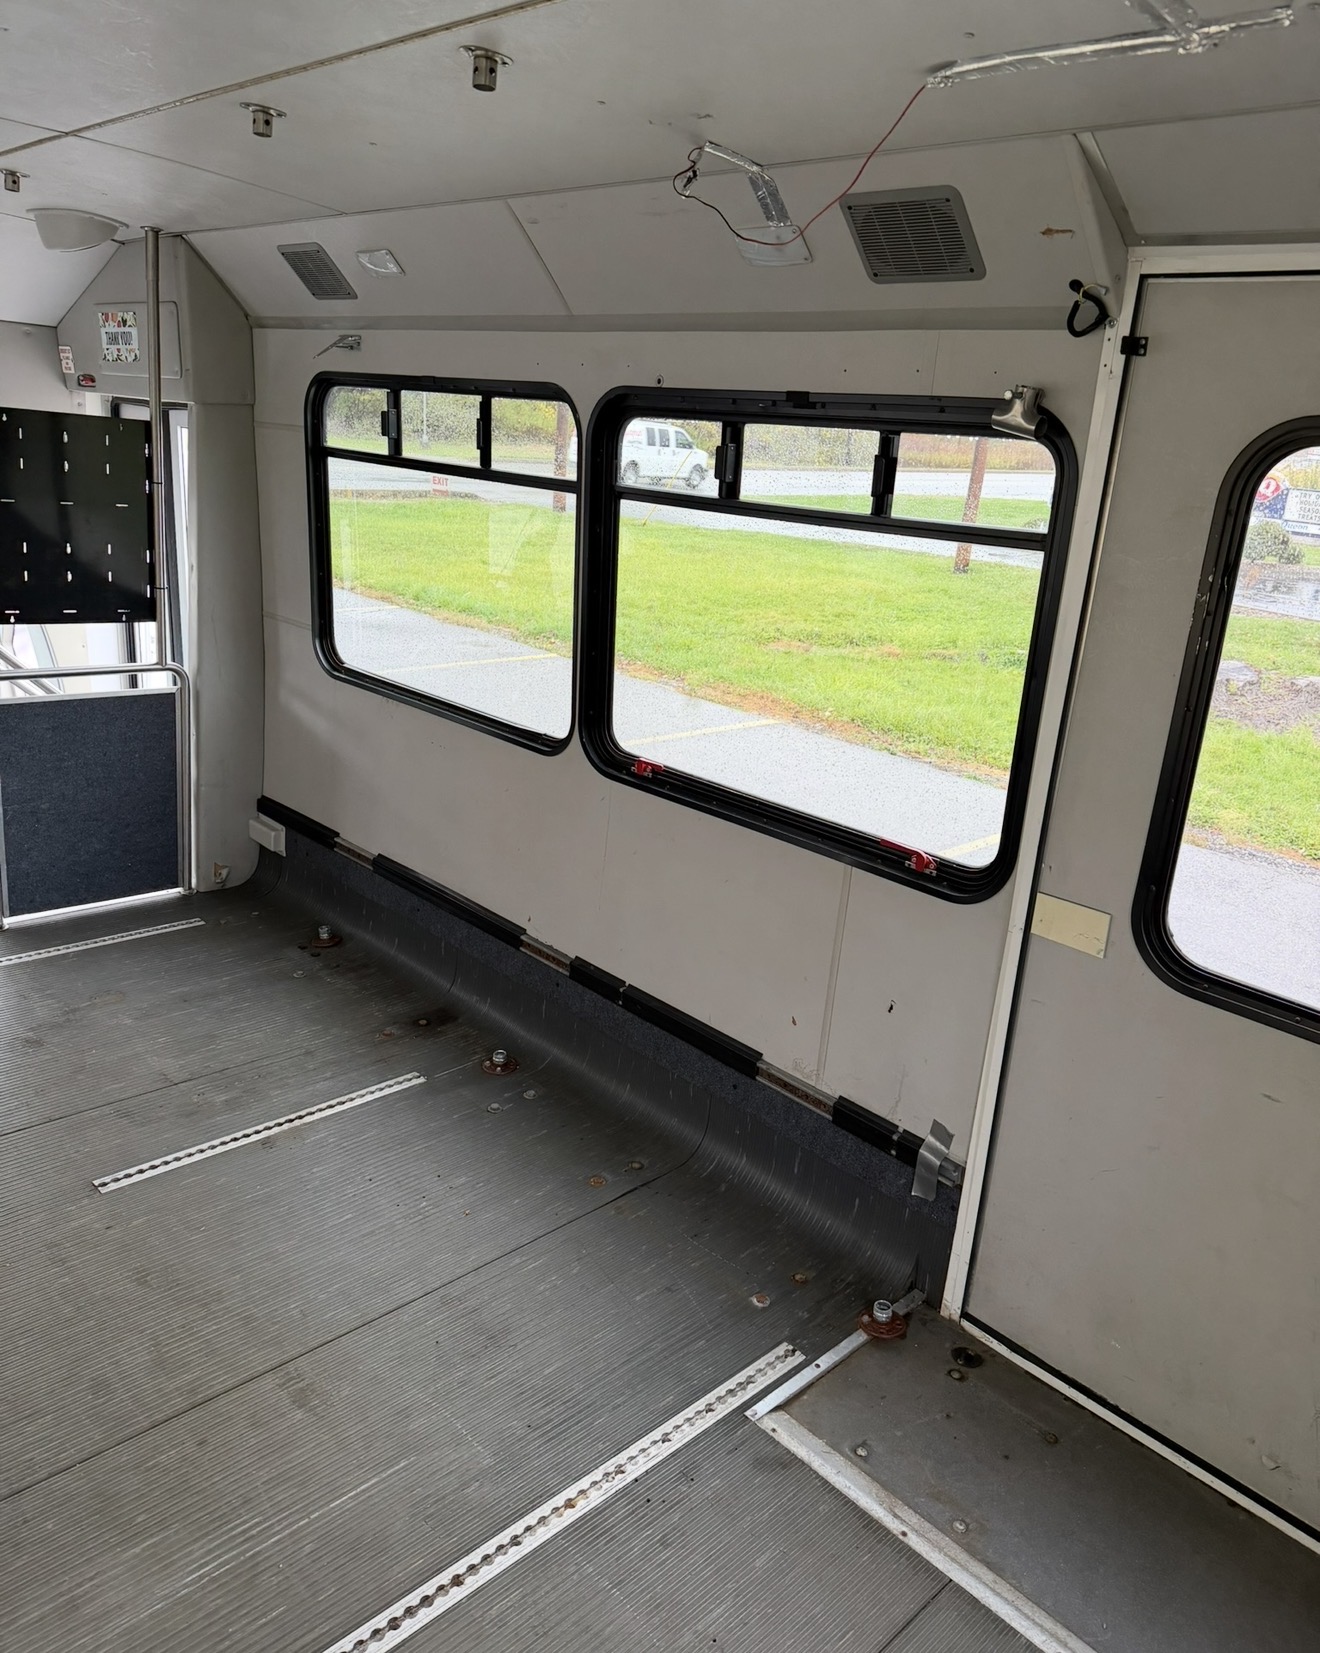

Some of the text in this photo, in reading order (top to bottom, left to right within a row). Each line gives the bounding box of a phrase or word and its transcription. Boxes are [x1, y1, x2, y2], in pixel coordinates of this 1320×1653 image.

[105, 331, 120, 346] THANK
[433, 476, 448, 487] EXIT
[1299, 492, 1312, 500] TRY
[1299, 506, 1320, 515] SEASO
